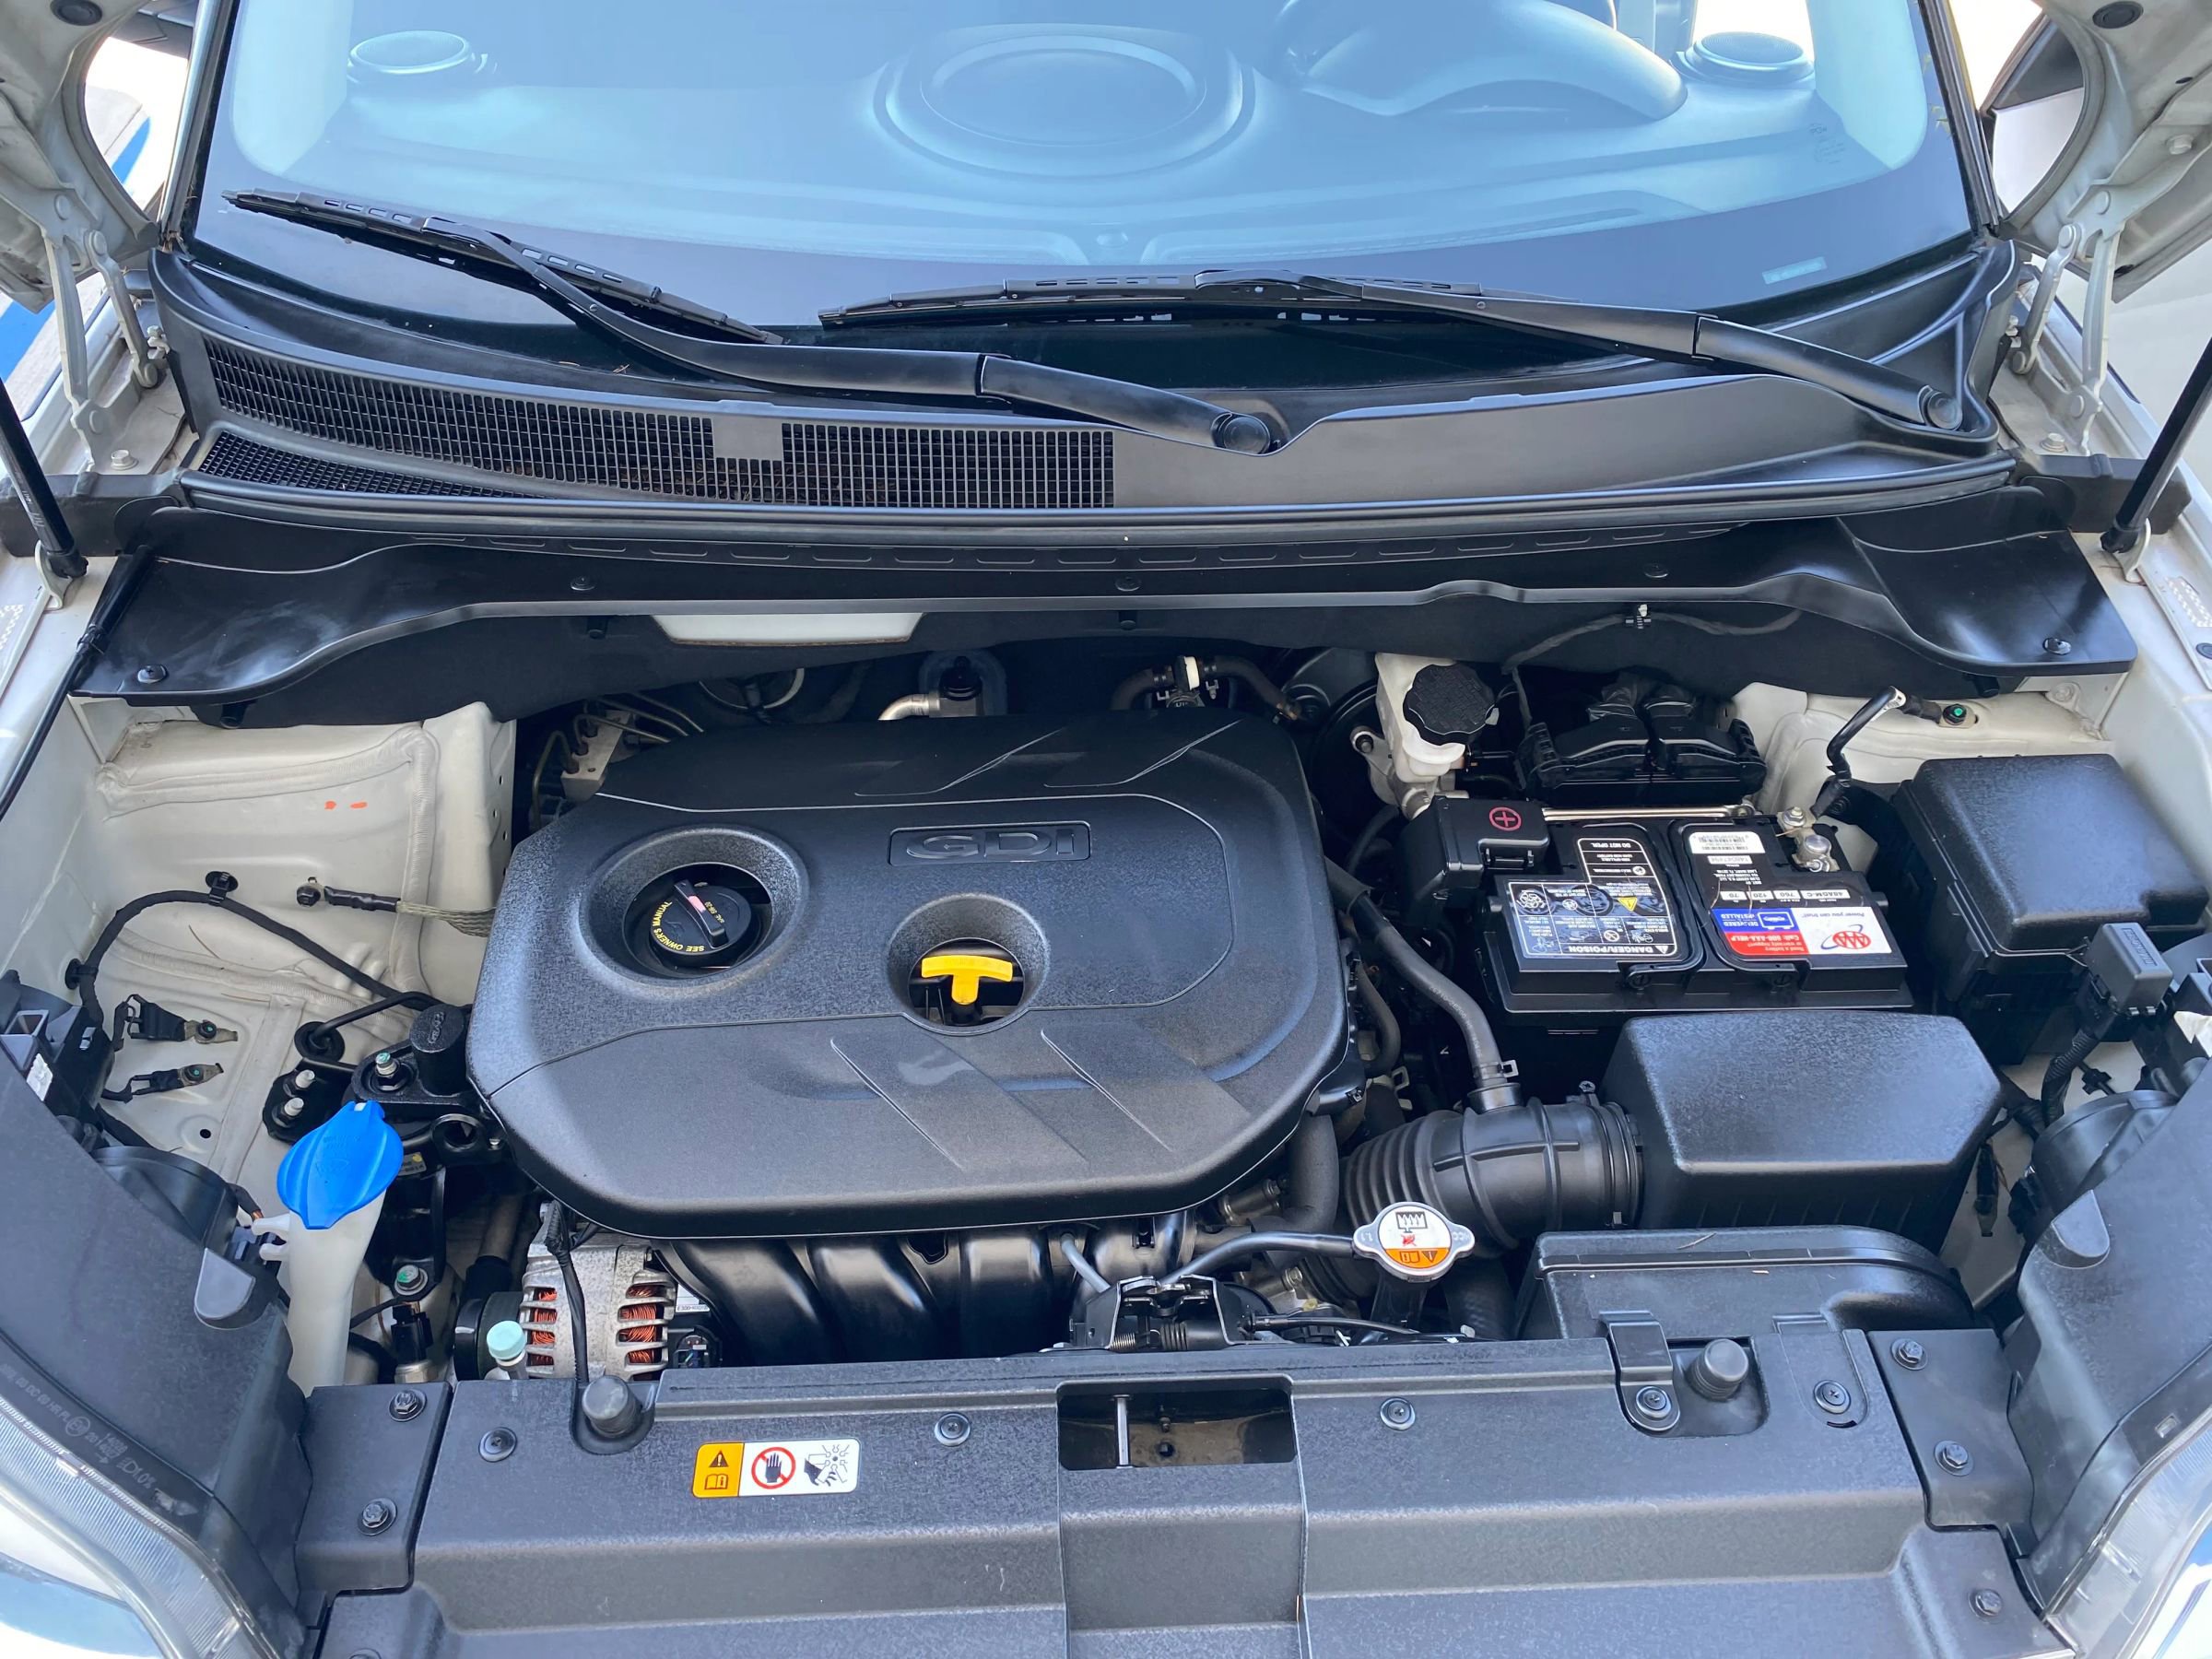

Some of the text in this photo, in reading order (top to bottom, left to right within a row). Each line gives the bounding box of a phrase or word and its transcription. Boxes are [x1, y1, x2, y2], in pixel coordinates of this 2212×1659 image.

[653, 901, 673, 926] MANUAL
[653, 928, 683, 950] OWNER'S
[1836, 933, 1865, 948] AAA
